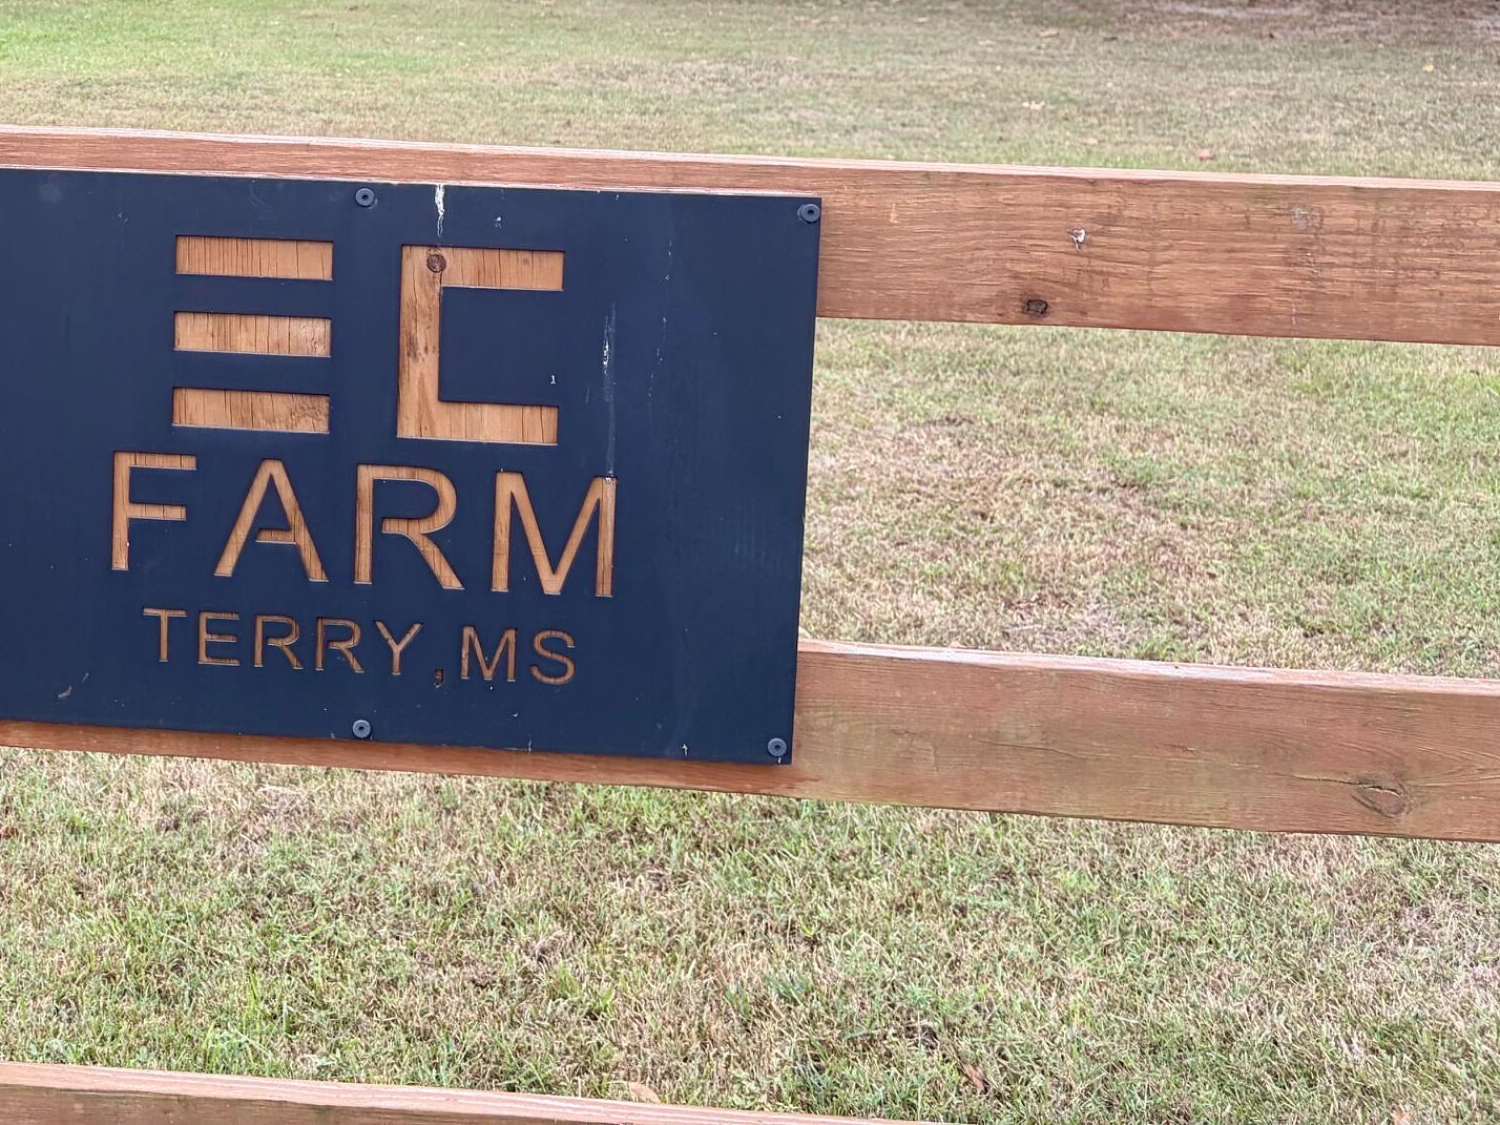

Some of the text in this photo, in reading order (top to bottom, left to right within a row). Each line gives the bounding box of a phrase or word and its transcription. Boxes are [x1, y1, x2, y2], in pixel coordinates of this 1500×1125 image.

[111, 450, 619, 598] FARM
[142, 607, 578, 688] TERRY, MS
